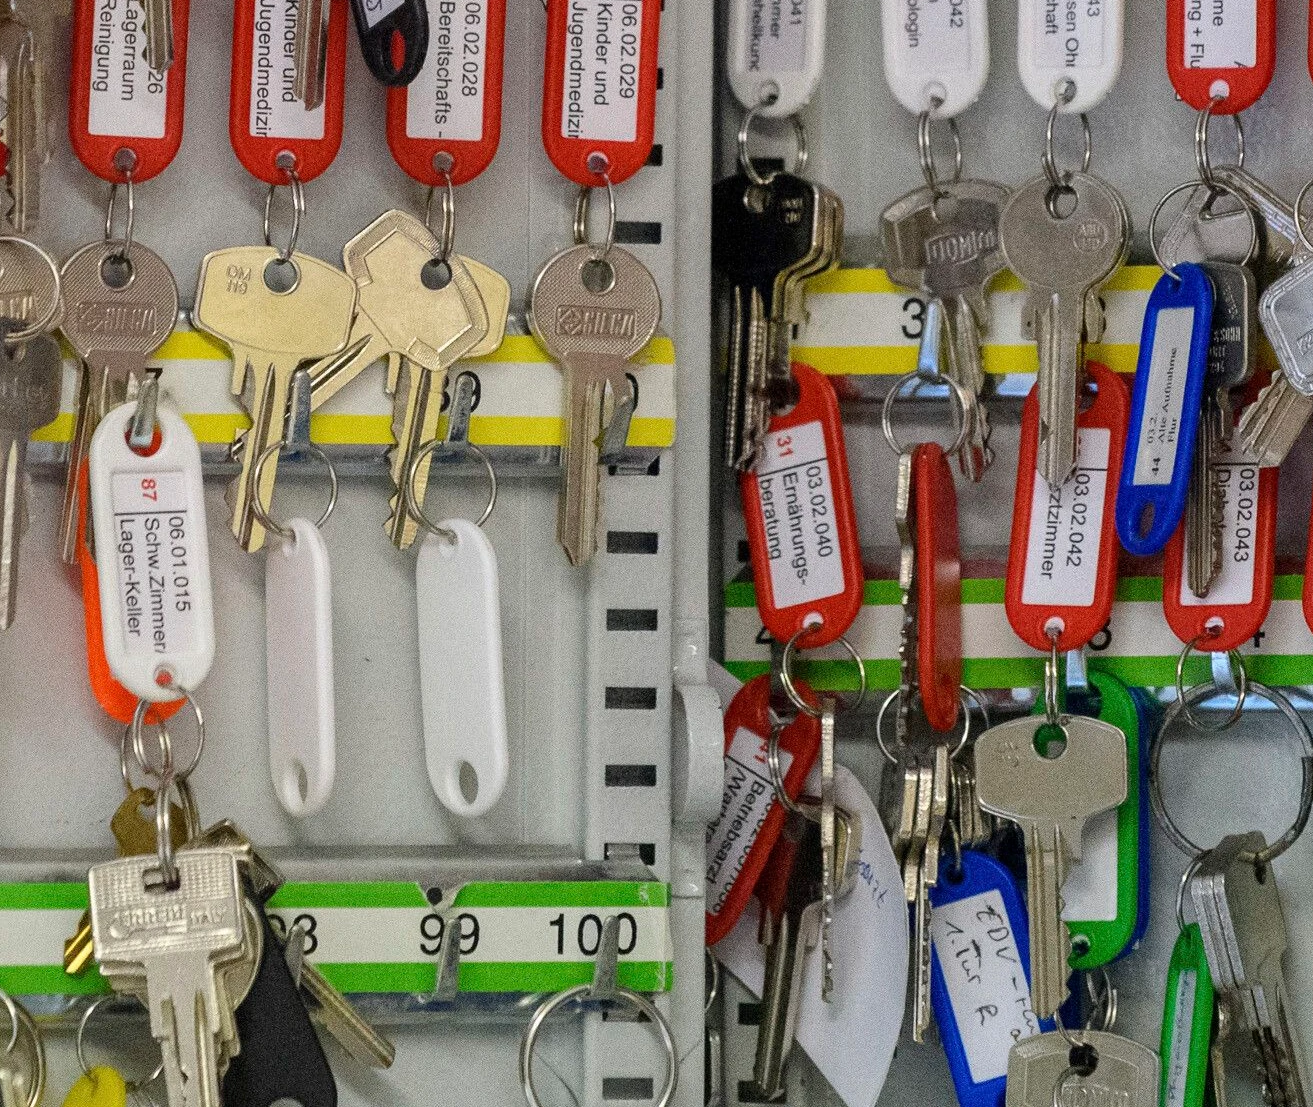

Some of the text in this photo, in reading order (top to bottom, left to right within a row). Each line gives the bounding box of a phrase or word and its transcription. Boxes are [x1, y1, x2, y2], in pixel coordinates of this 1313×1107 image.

[435, 2, 455, 123] Bereitschafts
[463, 2, 479, 96] 06.02.028
[594, 3, 612, 105] Kinder und
[620, 4, 643, 99] 06.02.029
[1162, 347, 1178, 414] Aufnahme
[141, 478, 157, 502] 87
[776, 434, 794, 457] 31
[760, 477, 781, 559] beratung
[782, 473, 808, 584] Ernährungs-
[807, 466, 833, 558] 03.02.040
[1065, 472, 1090, 567] 03.02.042
[1235, 469, 1256, 562] 03.02.043
[118, 519, 141, 637] Lager-Keller
[170, 515, 191, 611] 06.01.015
[421, 914, 480, 955] 99
[549, 914, 637, 955] 100
